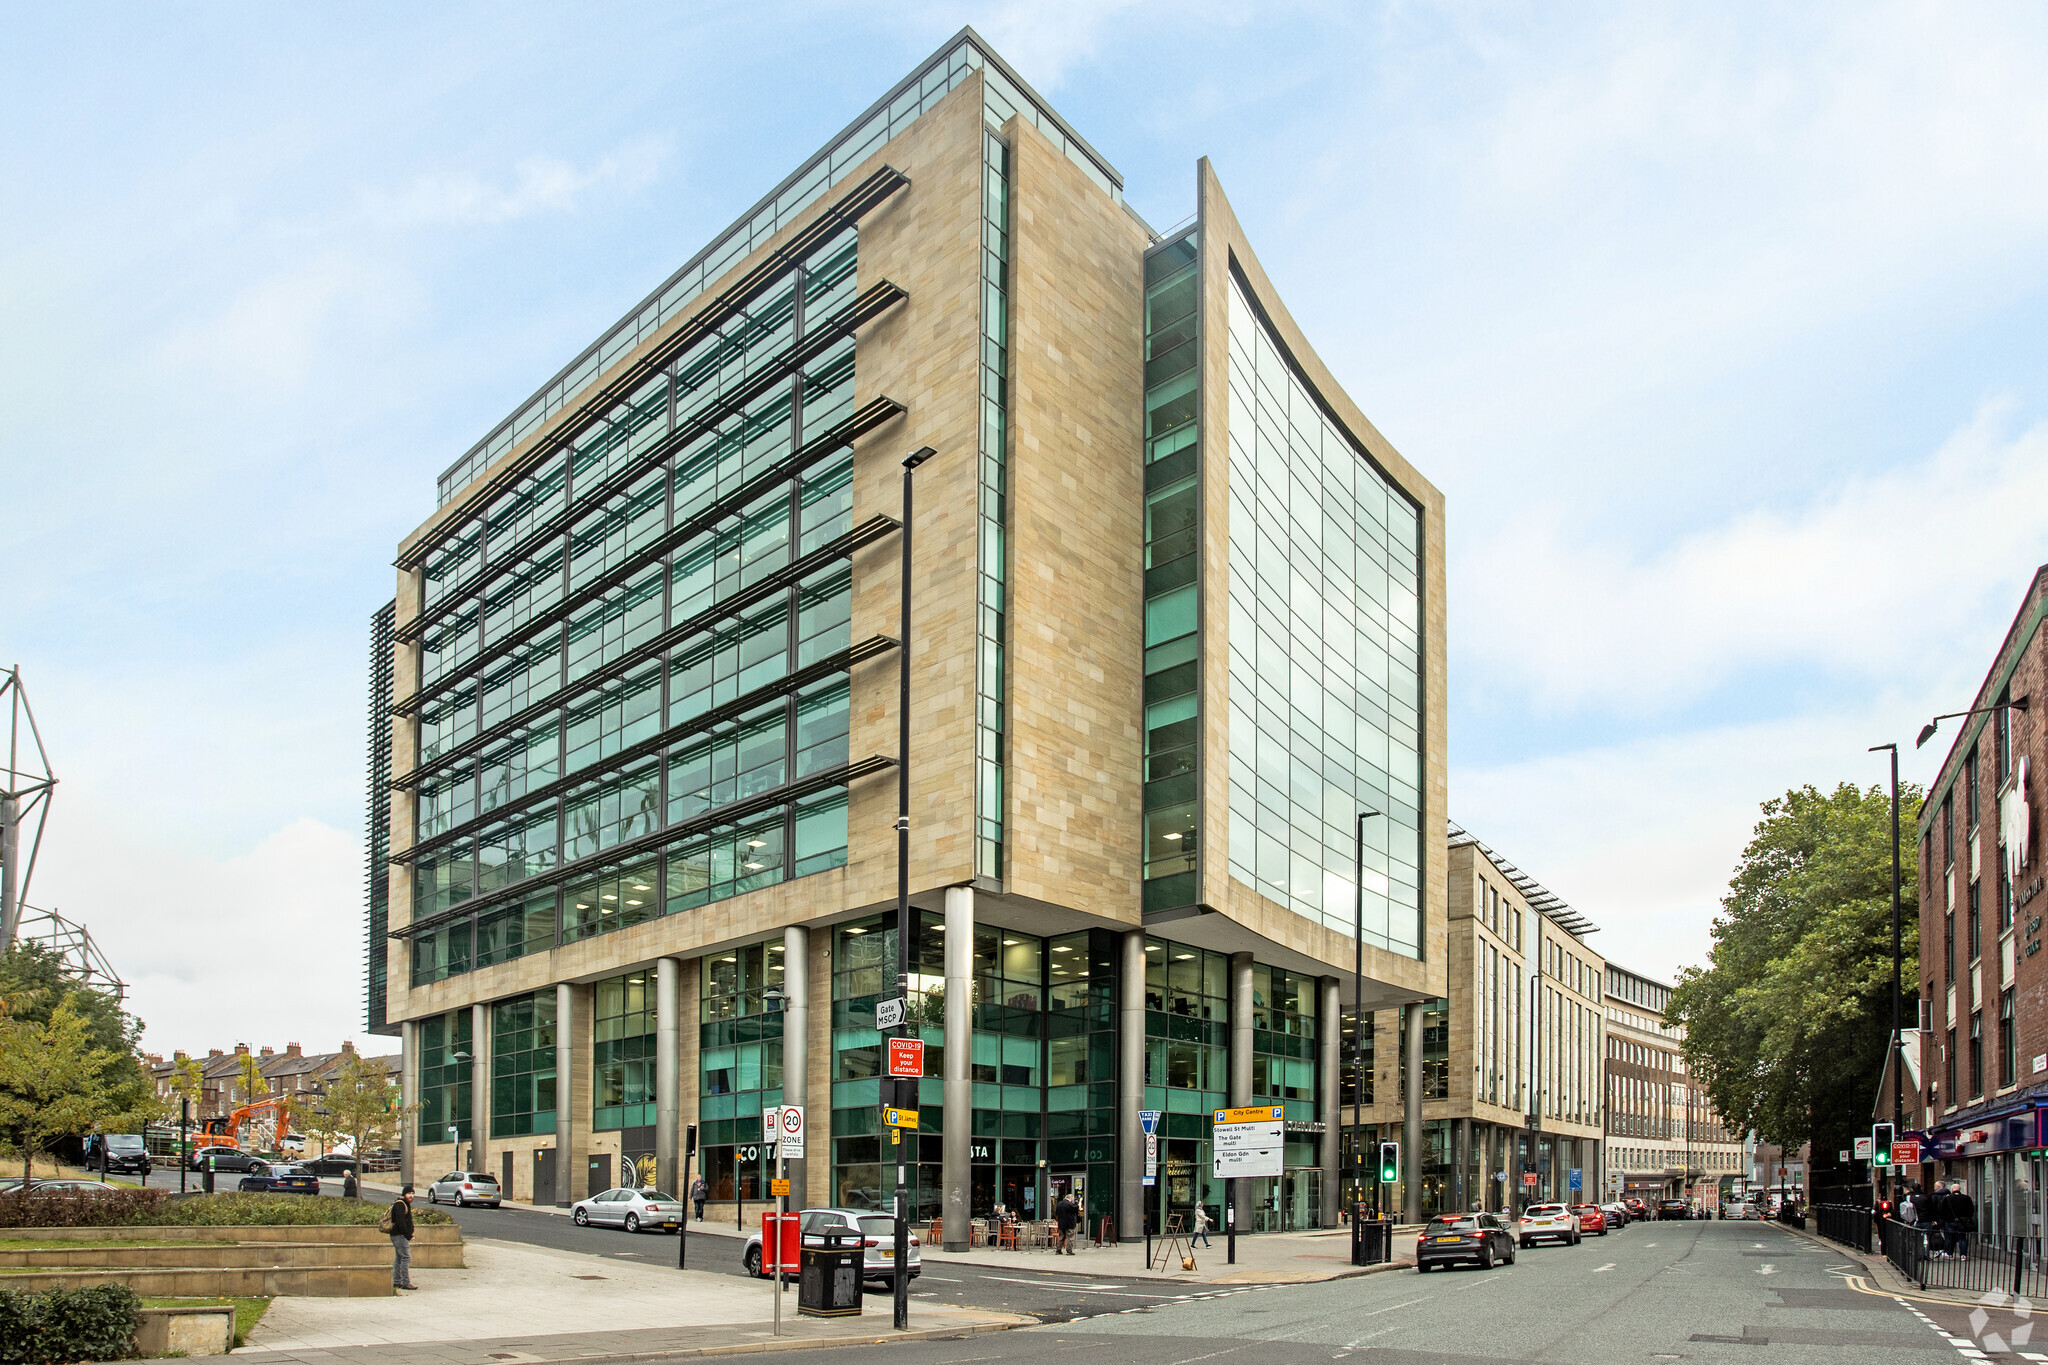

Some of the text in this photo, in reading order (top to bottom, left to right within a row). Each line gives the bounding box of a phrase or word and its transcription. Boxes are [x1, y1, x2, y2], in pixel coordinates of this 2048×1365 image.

[880, 1005, 894, 1014] Gate
[878, 1014, 897, 1026] MSCP
[891, 1041, 921, 1050] COVID-19
[899, 1051, 914, 1060] Keep
[900, 1059, 913, 1067] your
[891, 1113, 897, 1122] P
[1218, 1112, 1225, 1121] P
[1274, 1109, 1281, 1118] P
[768, 1116, 774, 1124] B
[786, 1116, 799, 1126] 20
